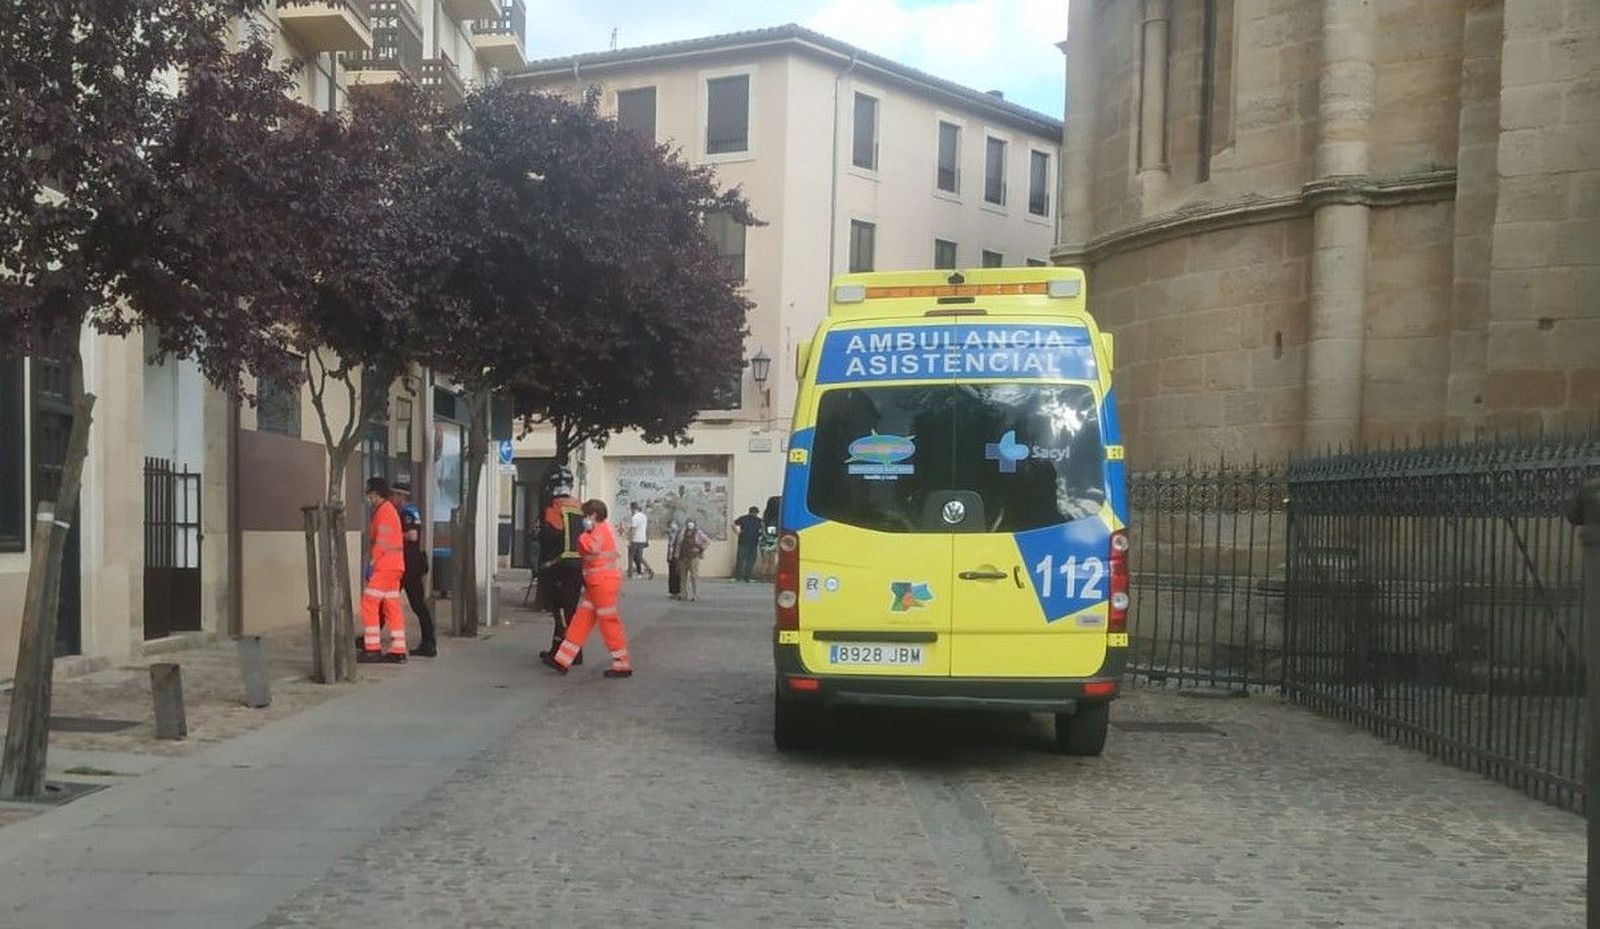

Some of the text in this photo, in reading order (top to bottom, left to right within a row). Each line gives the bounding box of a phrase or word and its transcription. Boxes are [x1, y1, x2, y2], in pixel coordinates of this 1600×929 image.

[845, 330, 1065, 354] AMBULANCIA
[845, 352, 1062, 376] ASISTENCIAL
[1031, 445, 1070, 461] Sacyl
[1036, 554, 1103, 599] 112
[840, 647, 882, 661] 8928
[889, 648, 920, 662] JBM
